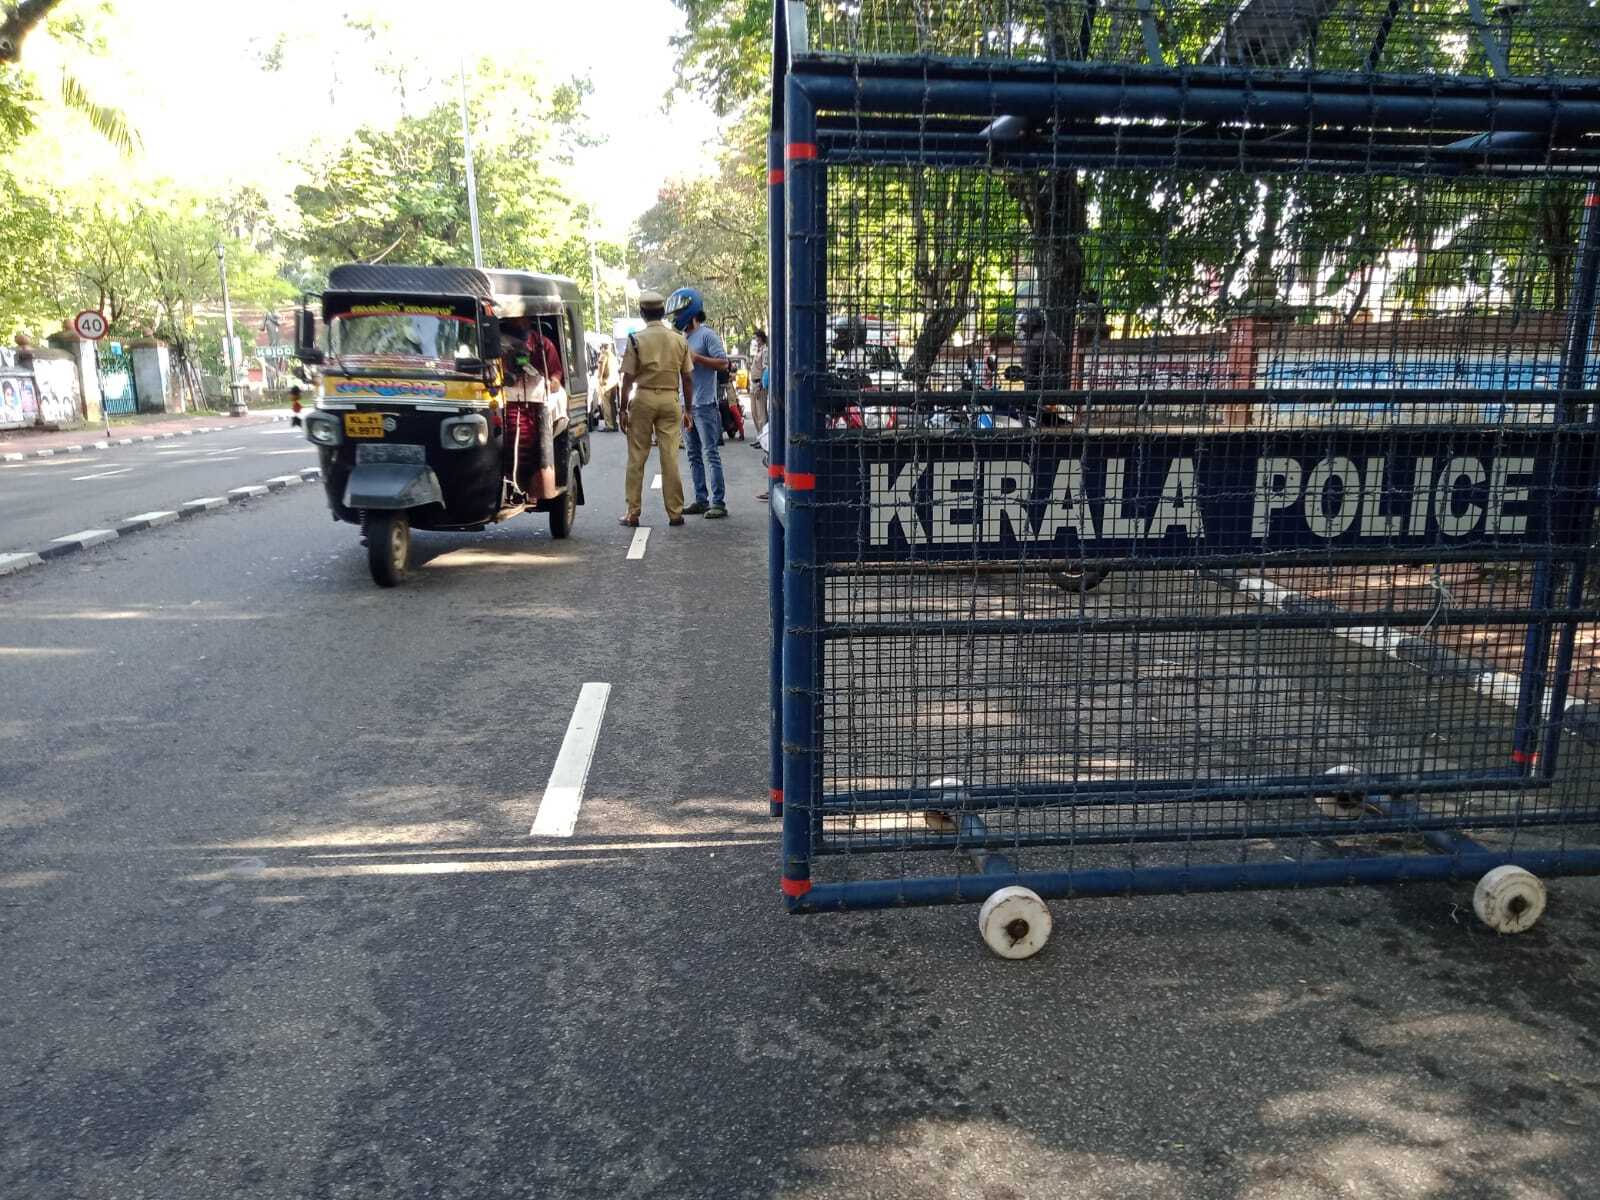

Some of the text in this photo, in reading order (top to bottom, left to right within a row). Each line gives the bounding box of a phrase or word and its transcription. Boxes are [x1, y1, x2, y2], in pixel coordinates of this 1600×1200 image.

[81, 319, 102, 332] 40
[869, 457, 1535, 546] KERALA POLICE
